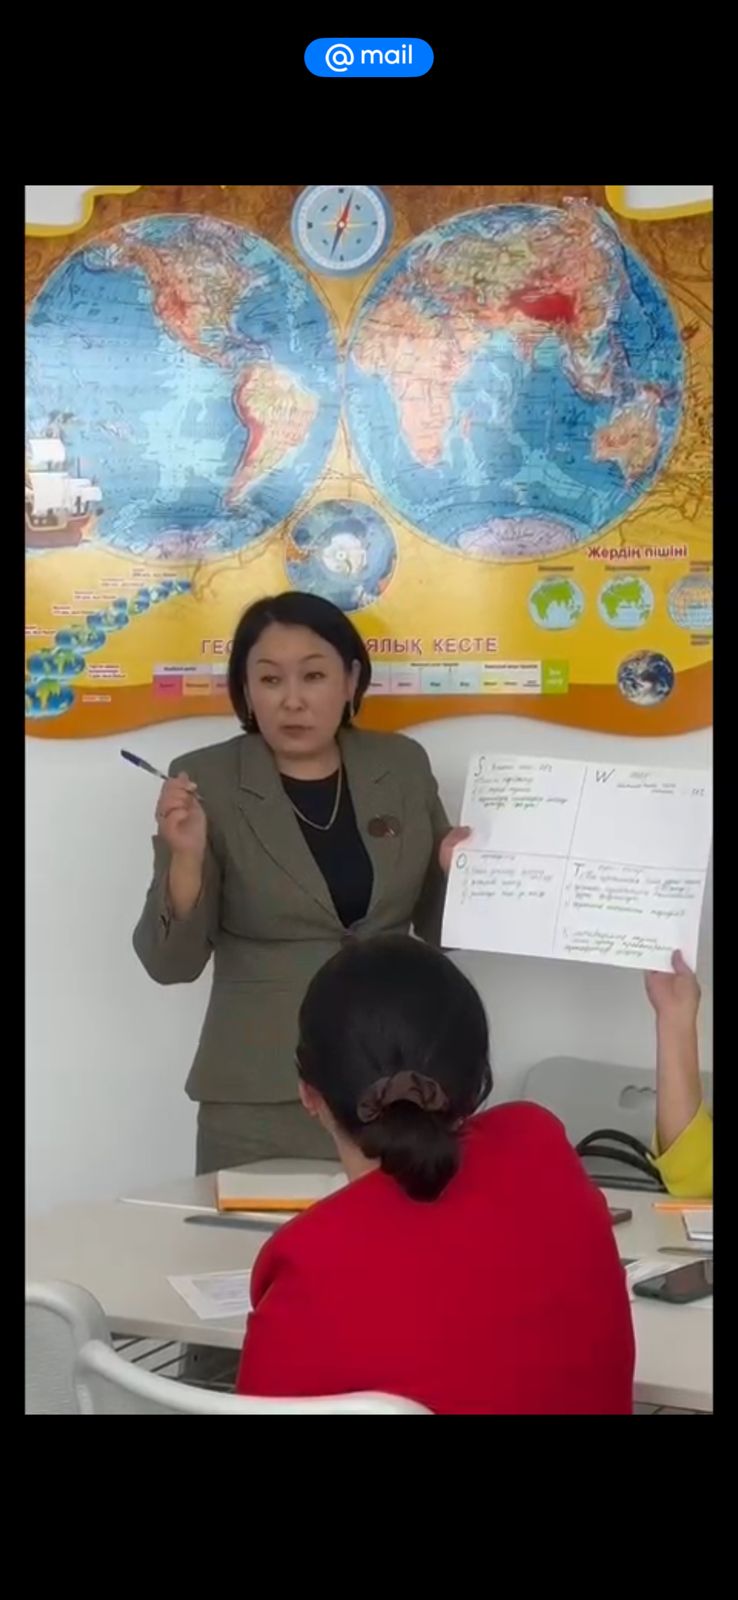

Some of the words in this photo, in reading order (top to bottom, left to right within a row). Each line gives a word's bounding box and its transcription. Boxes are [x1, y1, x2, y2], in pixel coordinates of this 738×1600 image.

[587, 545, 641, 559] Жердің
[645, 544, 688, 558] пішіні
[434, 637, 498, 653] КЕСТЕ
[595, 768, 615, 783] W
